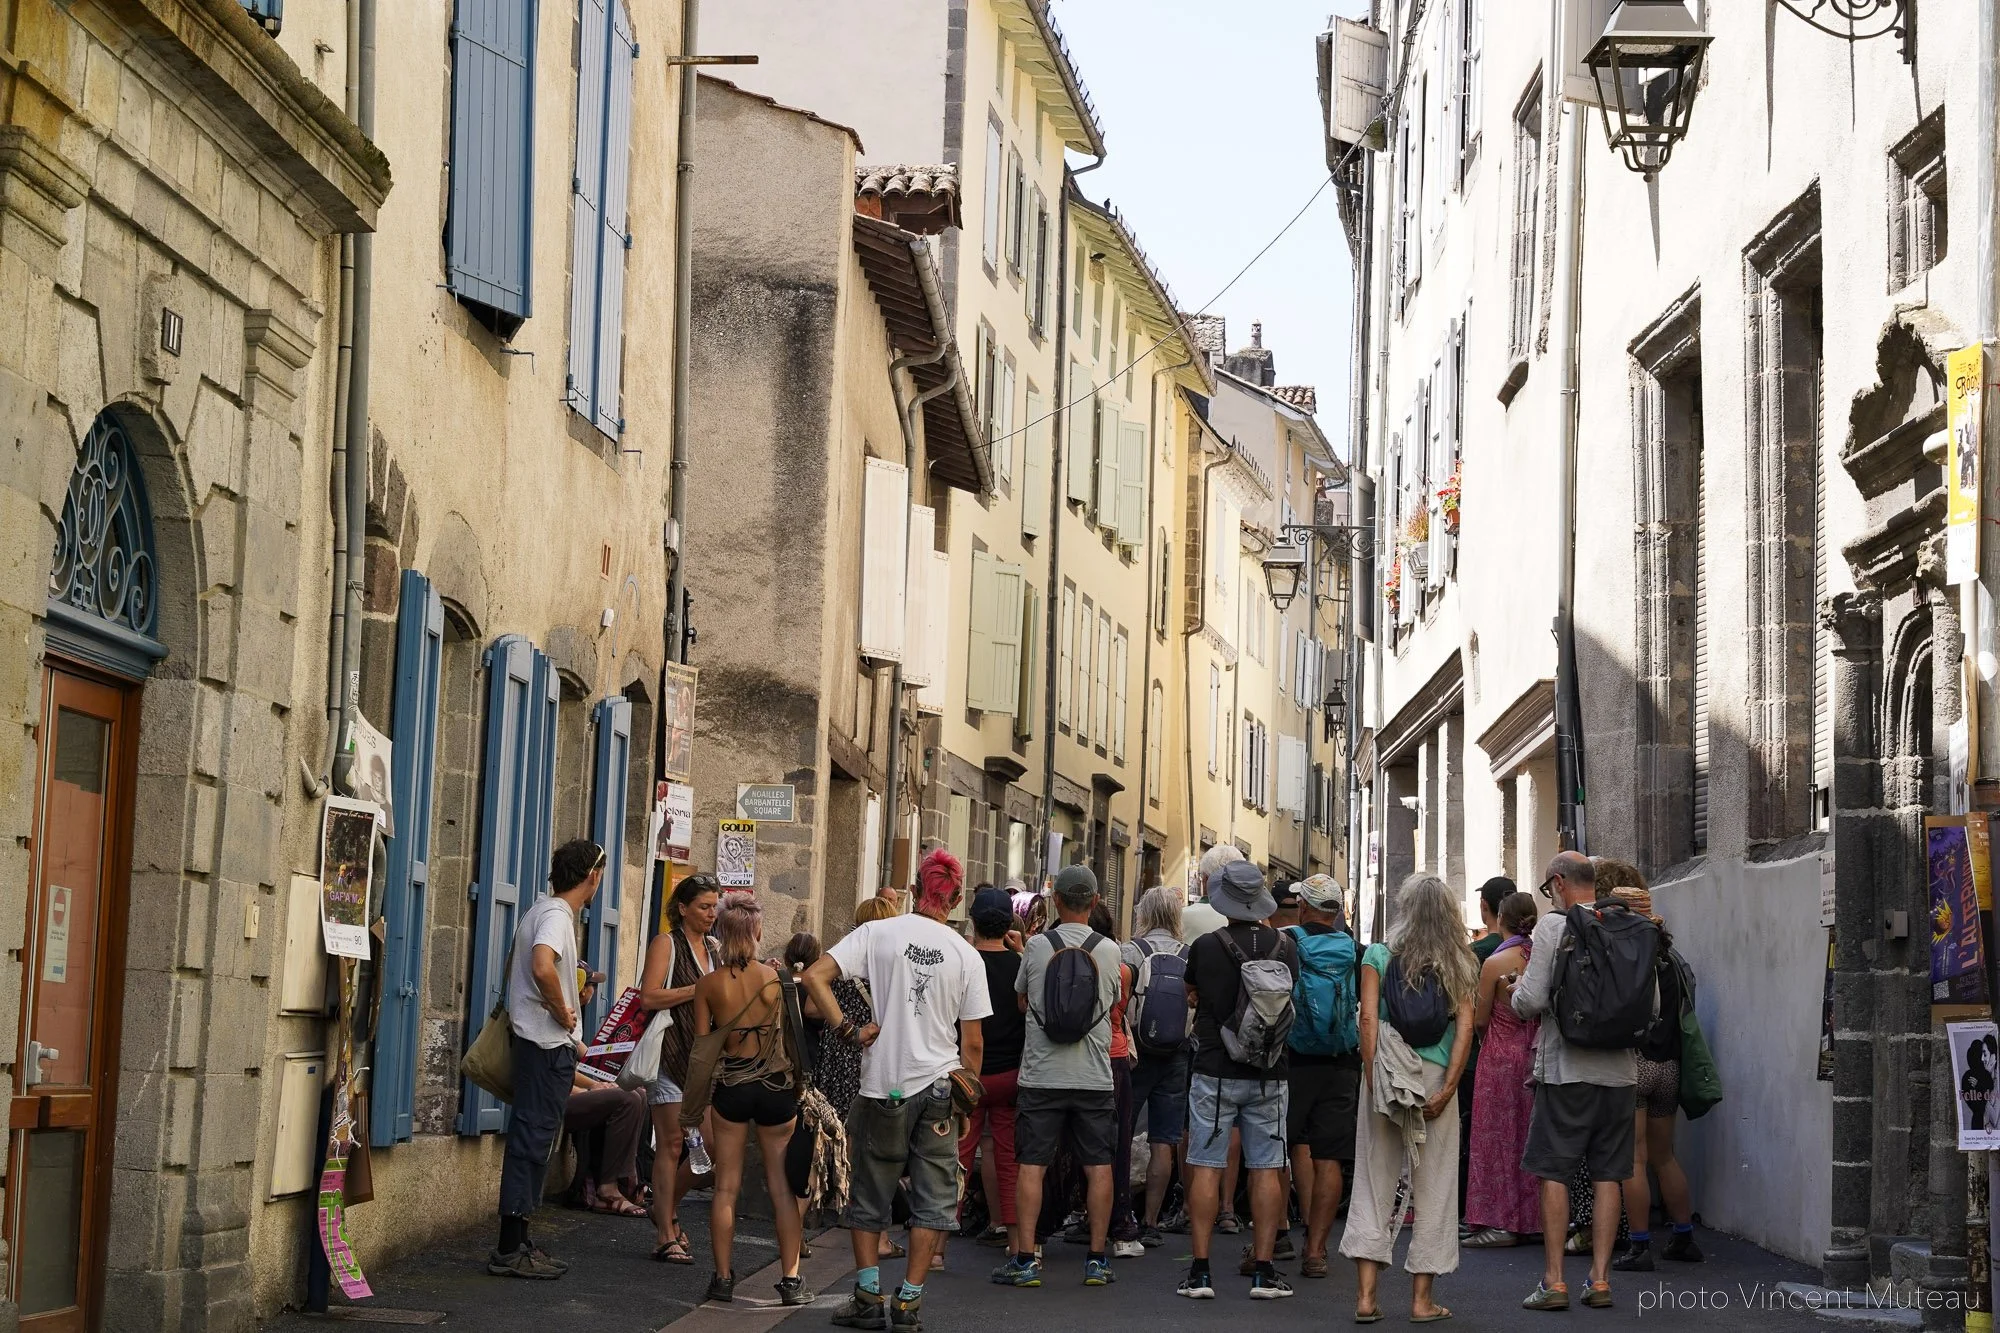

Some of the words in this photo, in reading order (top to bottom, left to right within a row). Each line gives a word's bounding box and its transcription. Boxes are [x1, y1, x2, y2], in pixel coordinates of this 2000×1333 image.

[751, 790, 785, 799] NOAILLES
[744, 798, 791, 807] BARBANTELLE
[659, 804, 691, 819] Vctoria
[753, 806, 782, 815] SQUARE
[721, 823, 754, 832] GOLDI
[354, 935, 362, 945] 90
[903, 949, 945, 966] FURIEUSES
[596, 990, 636, 1043] NATACHA
